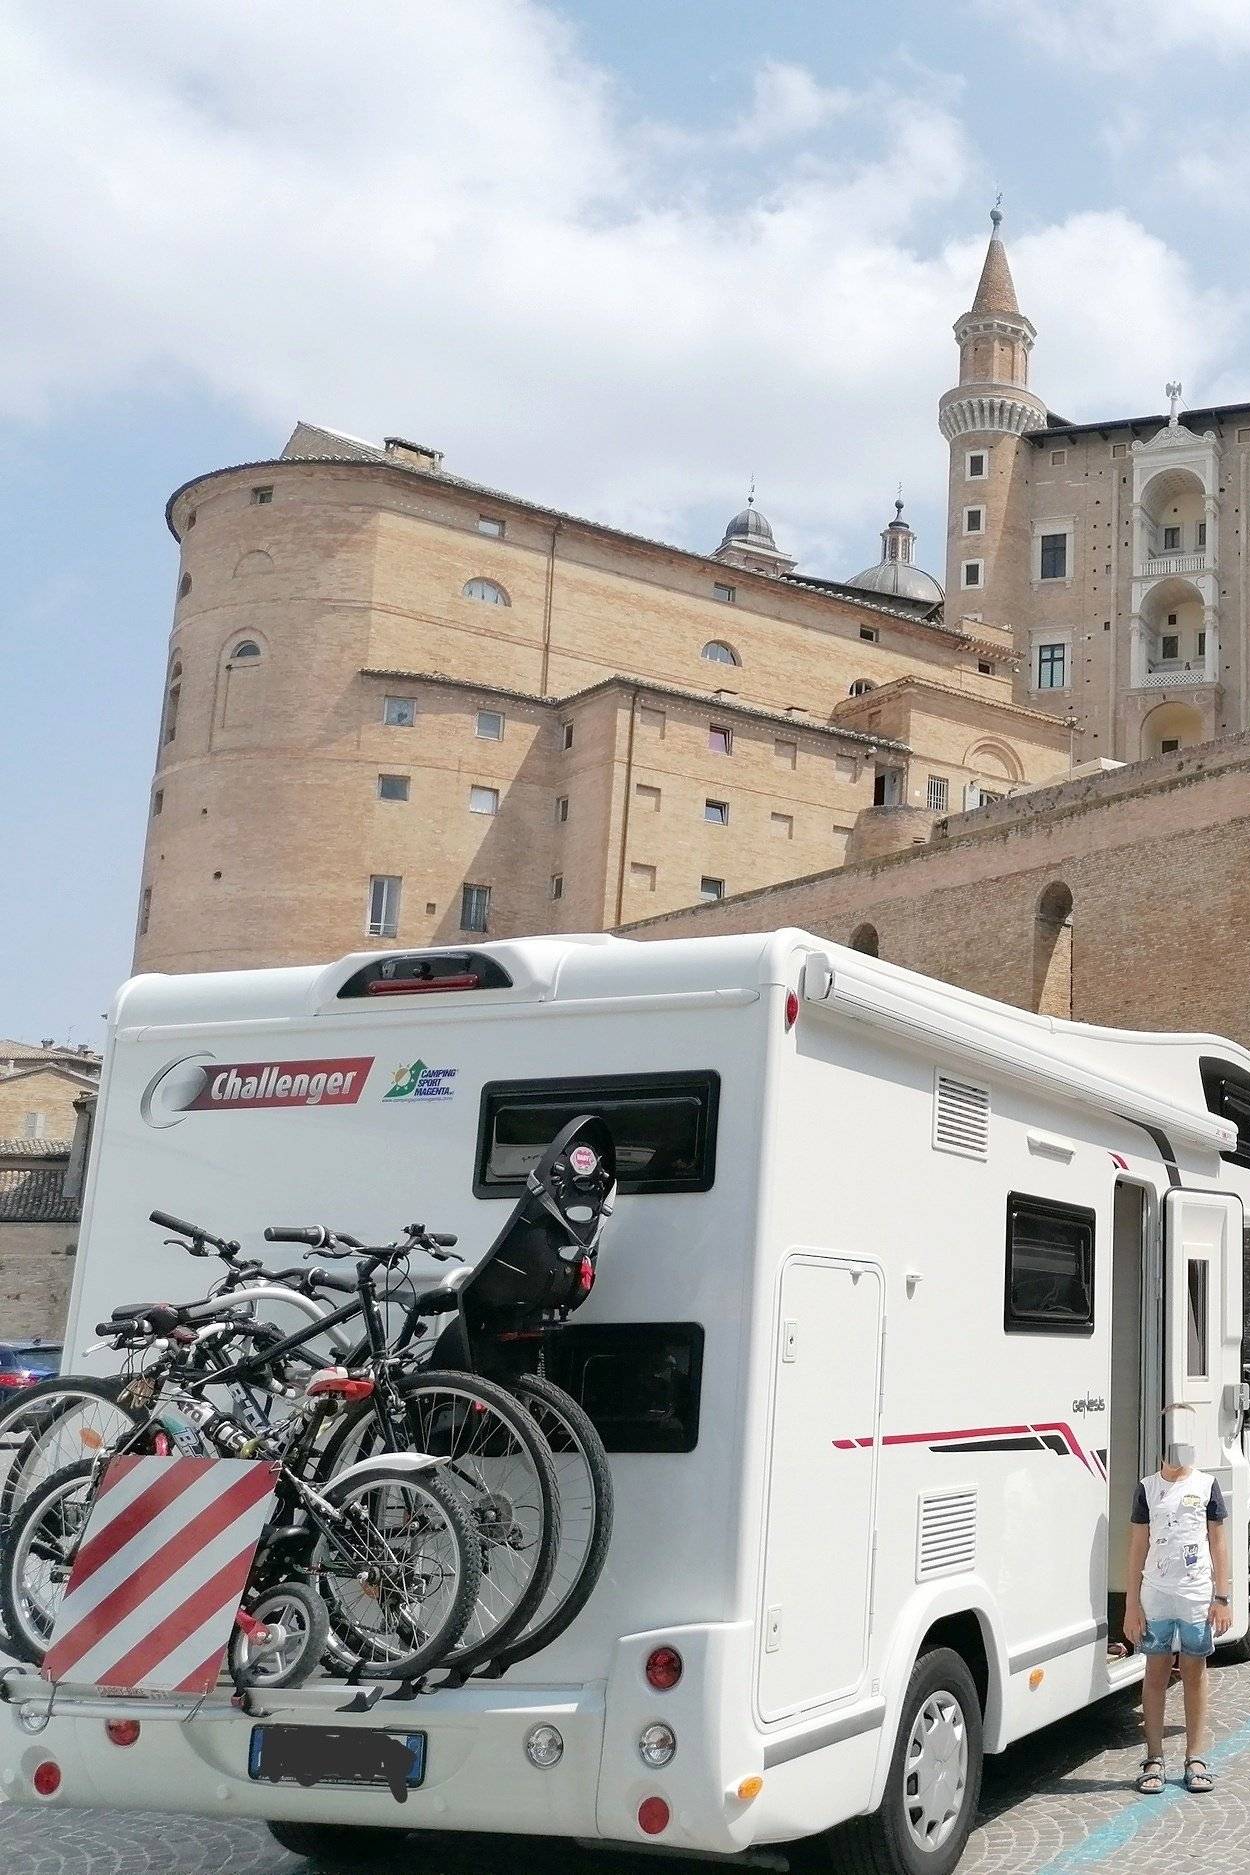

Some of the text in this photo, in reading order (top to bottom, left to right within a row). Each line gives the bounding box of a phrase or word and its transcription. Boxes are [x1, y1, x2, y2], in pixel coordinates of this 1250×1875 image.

[421, 1068, 456, 1078] CAMPING
[211, 1066, 357, 1104] Challenger
[418, 1078, 441, 1087] SPORT
[414, 1087, 449, 1096] MAGENTA
